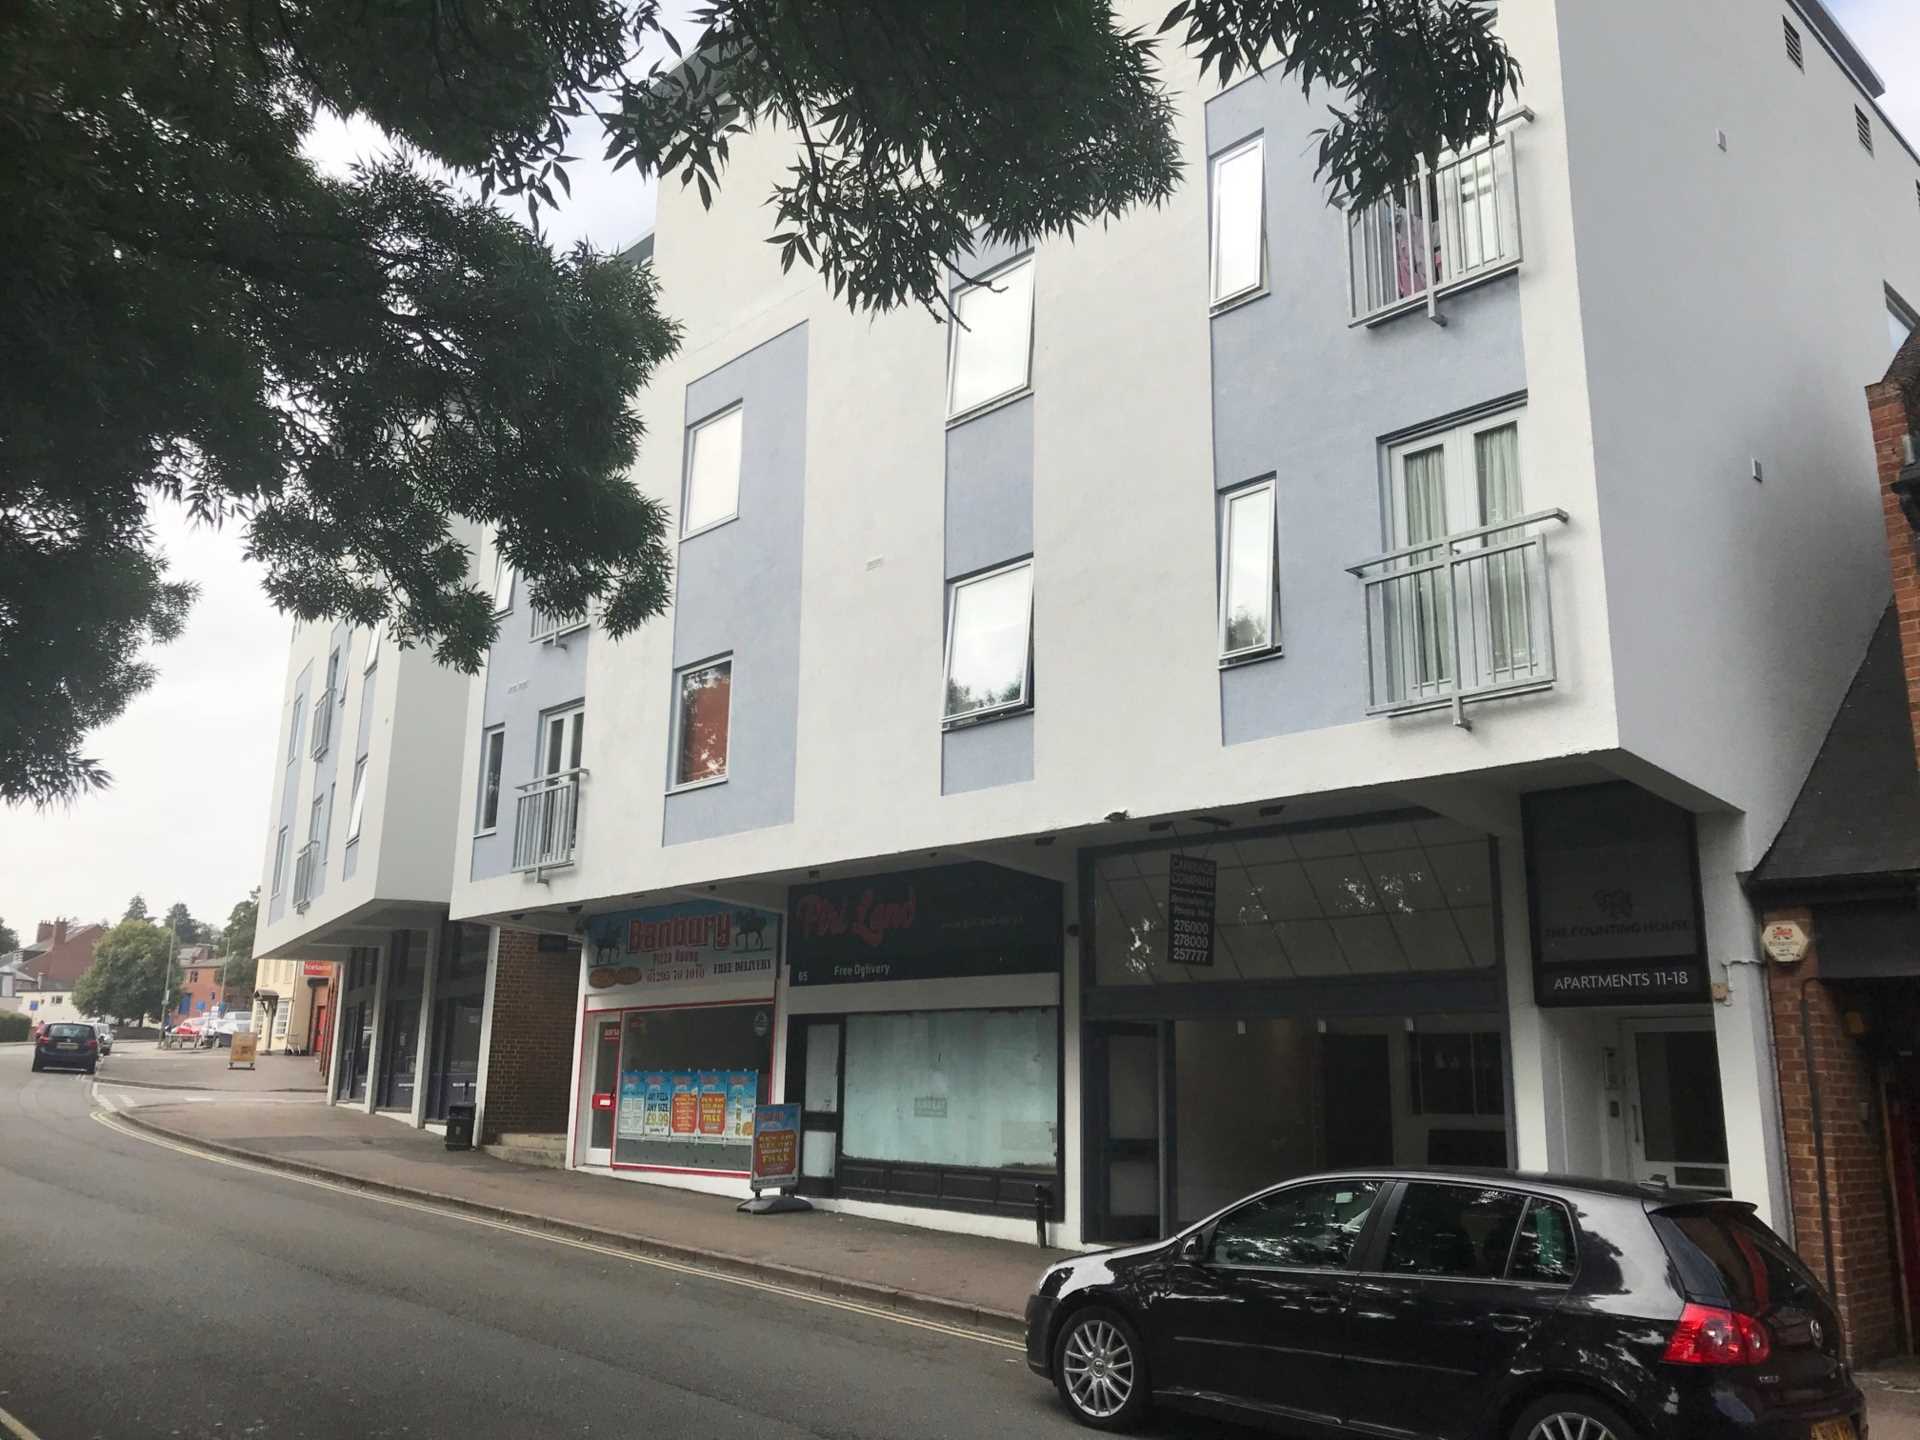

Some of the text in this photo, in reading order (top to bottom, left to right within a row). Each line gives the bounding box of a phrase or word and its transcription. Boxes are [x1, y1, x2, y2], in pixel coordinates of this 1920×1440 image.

[627, 912, 733, 953] Banbury
[1173, 933, 1209, 949] 278000
[713, 959, 772, 974] FREE DELIVERY
[833, 965, 852, 976] Free
[1554, 971, 1689, 990] APARTMENTS 11-18
[658, 1103, 669, 1112] SIZE
